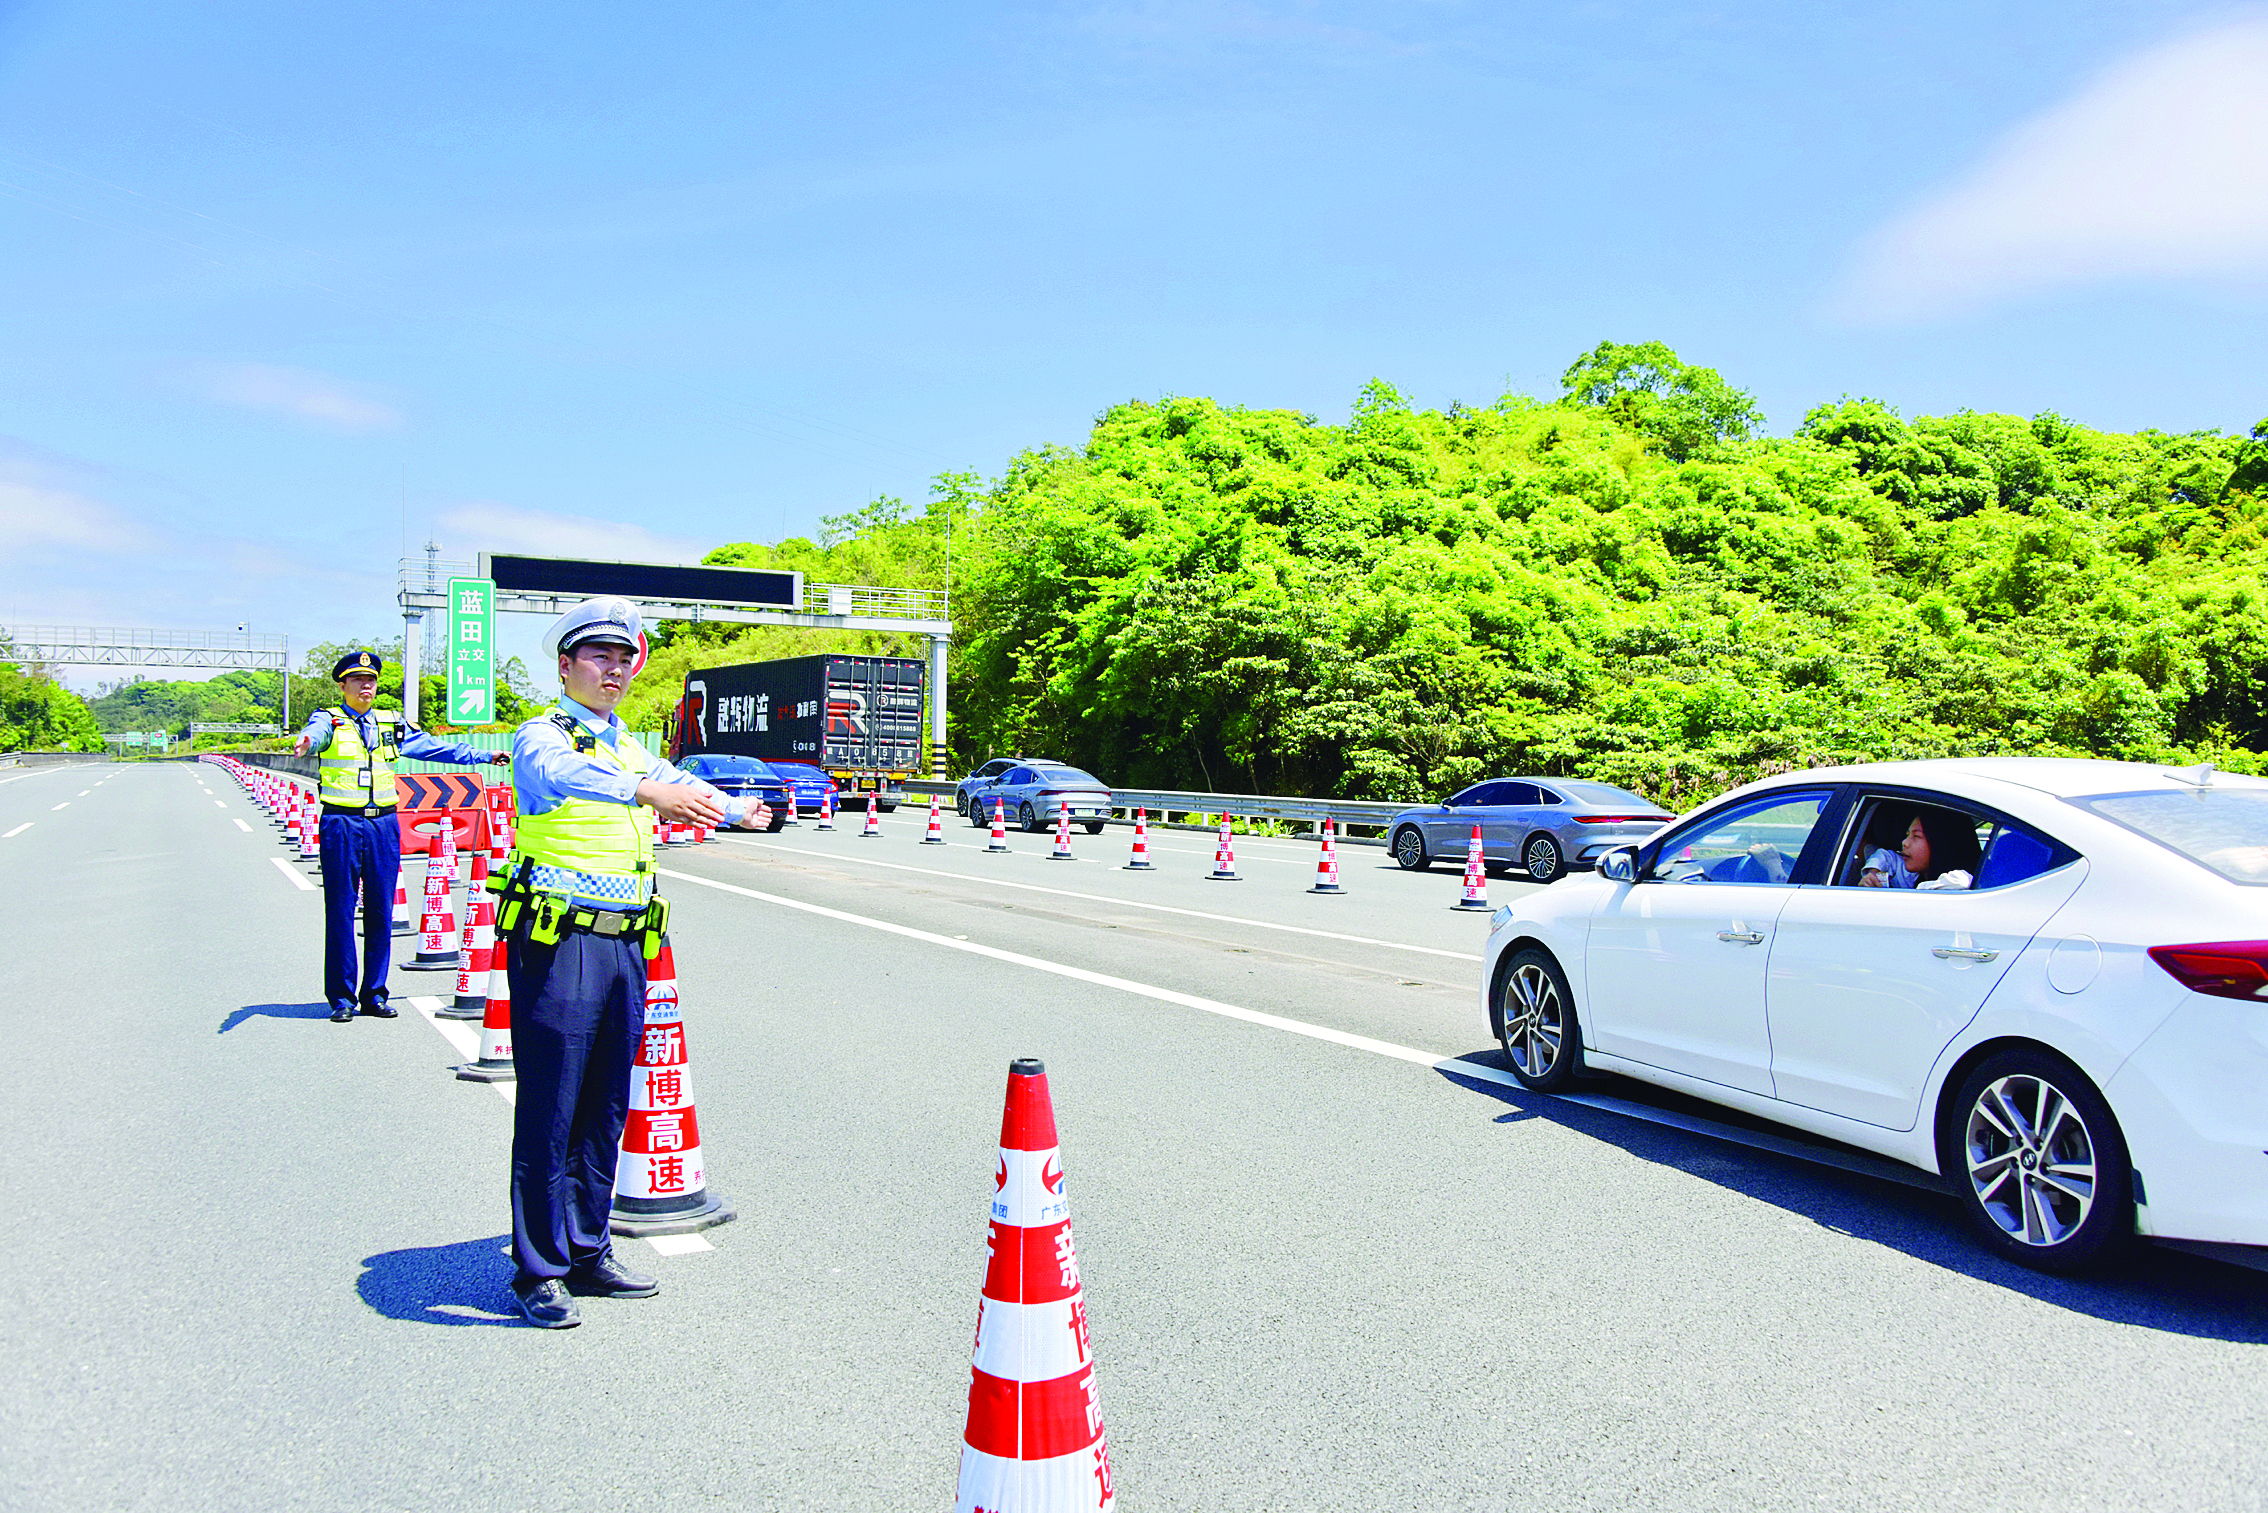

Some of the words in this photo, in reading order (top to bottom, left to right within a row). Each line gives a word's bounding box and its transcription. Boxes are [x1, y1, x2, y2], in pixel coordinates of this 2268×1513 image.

[459, 590, 484, 643] 蓝田
[456, 665, 486, 685] 1km
[457, 648, 485, 661] 立交
[425, 877, 444, 950] 新博高速
[645, 1026, 685, 1195] 新博高速
